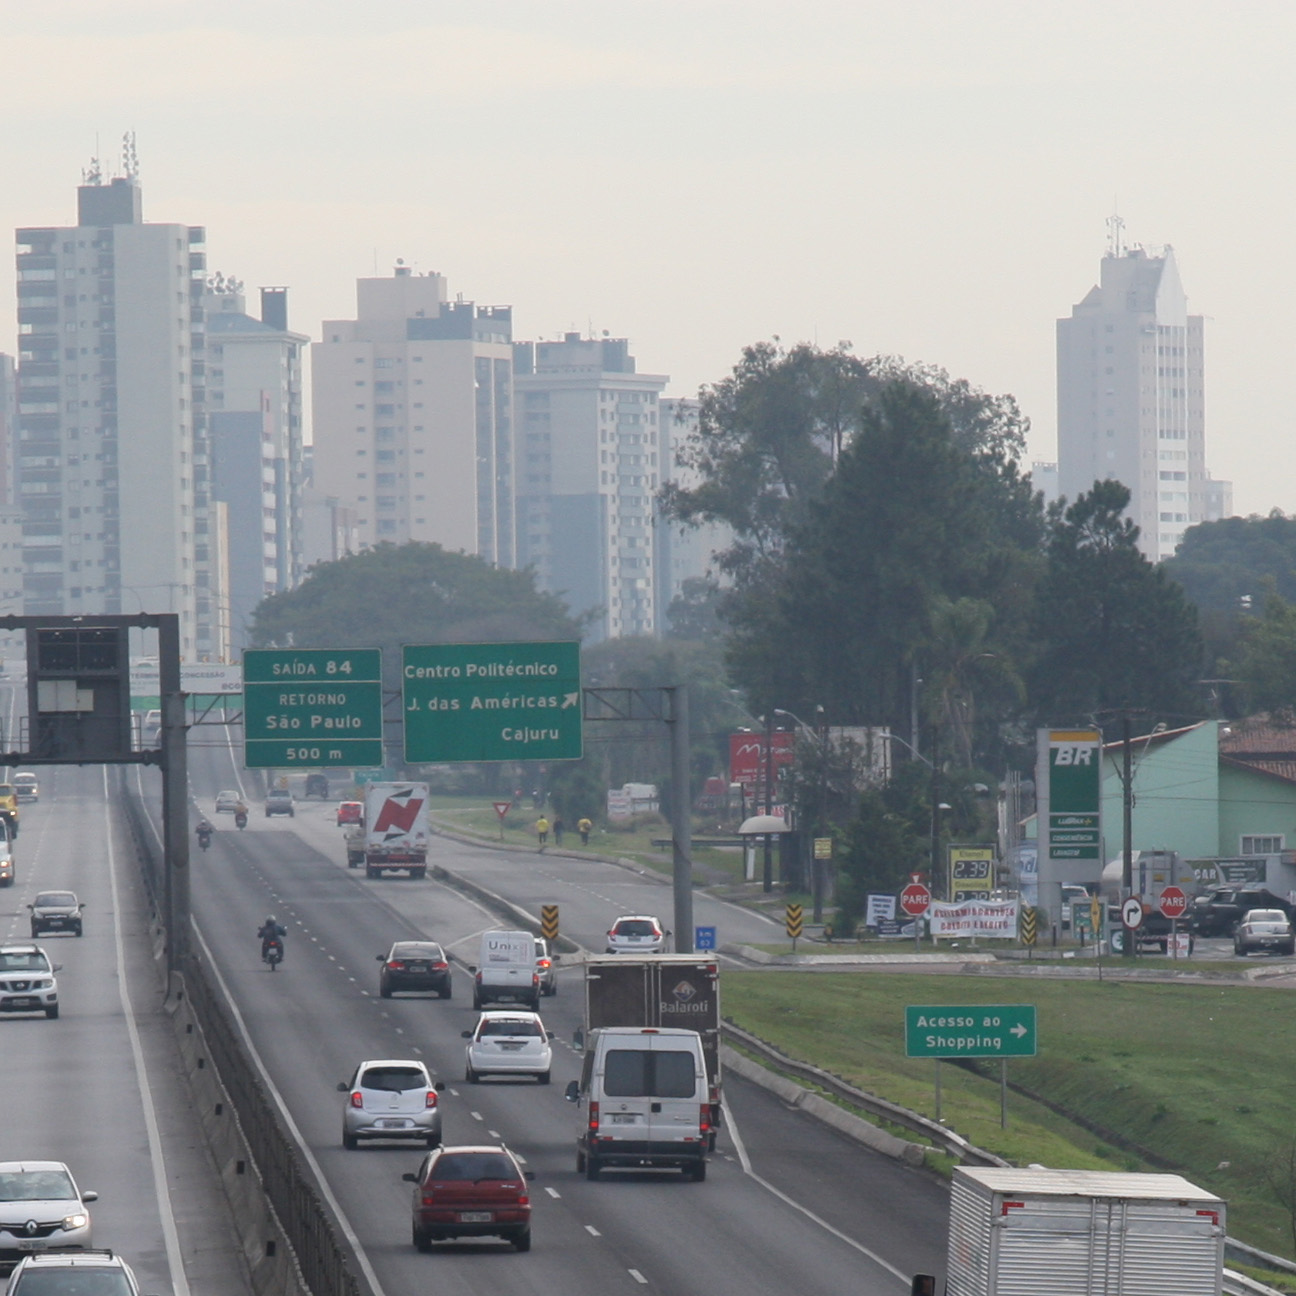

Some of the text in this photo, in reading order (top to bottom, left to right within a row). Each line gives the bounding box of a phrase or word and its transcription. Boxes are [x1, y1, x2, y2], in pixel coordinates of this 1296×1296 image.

[272, 658, 352, 675] SAÍDA 84
[404, 660, 558, 679] Centro Politécnico
[279, 694, 347, 706] RETORNO
[407, 693, 557, 711] J. das Américas
[266, 714, 362, 730] São Paulo
[501, 727, 559, 743] Cajuru
[286, 747, 342, 760] 500 m
[1054, 745, 1093, 766] BR
[954, 861, 989, 879] 2.39
[903, 894, 929, 905] PARE
[1160, 896, 1185, 908] PARE
[660, 1000, 708, 1013] Balaroti
[917, 1015, 1001, 1028] Acesso ao
[926, 1034, 1003, 1051] Shopping
